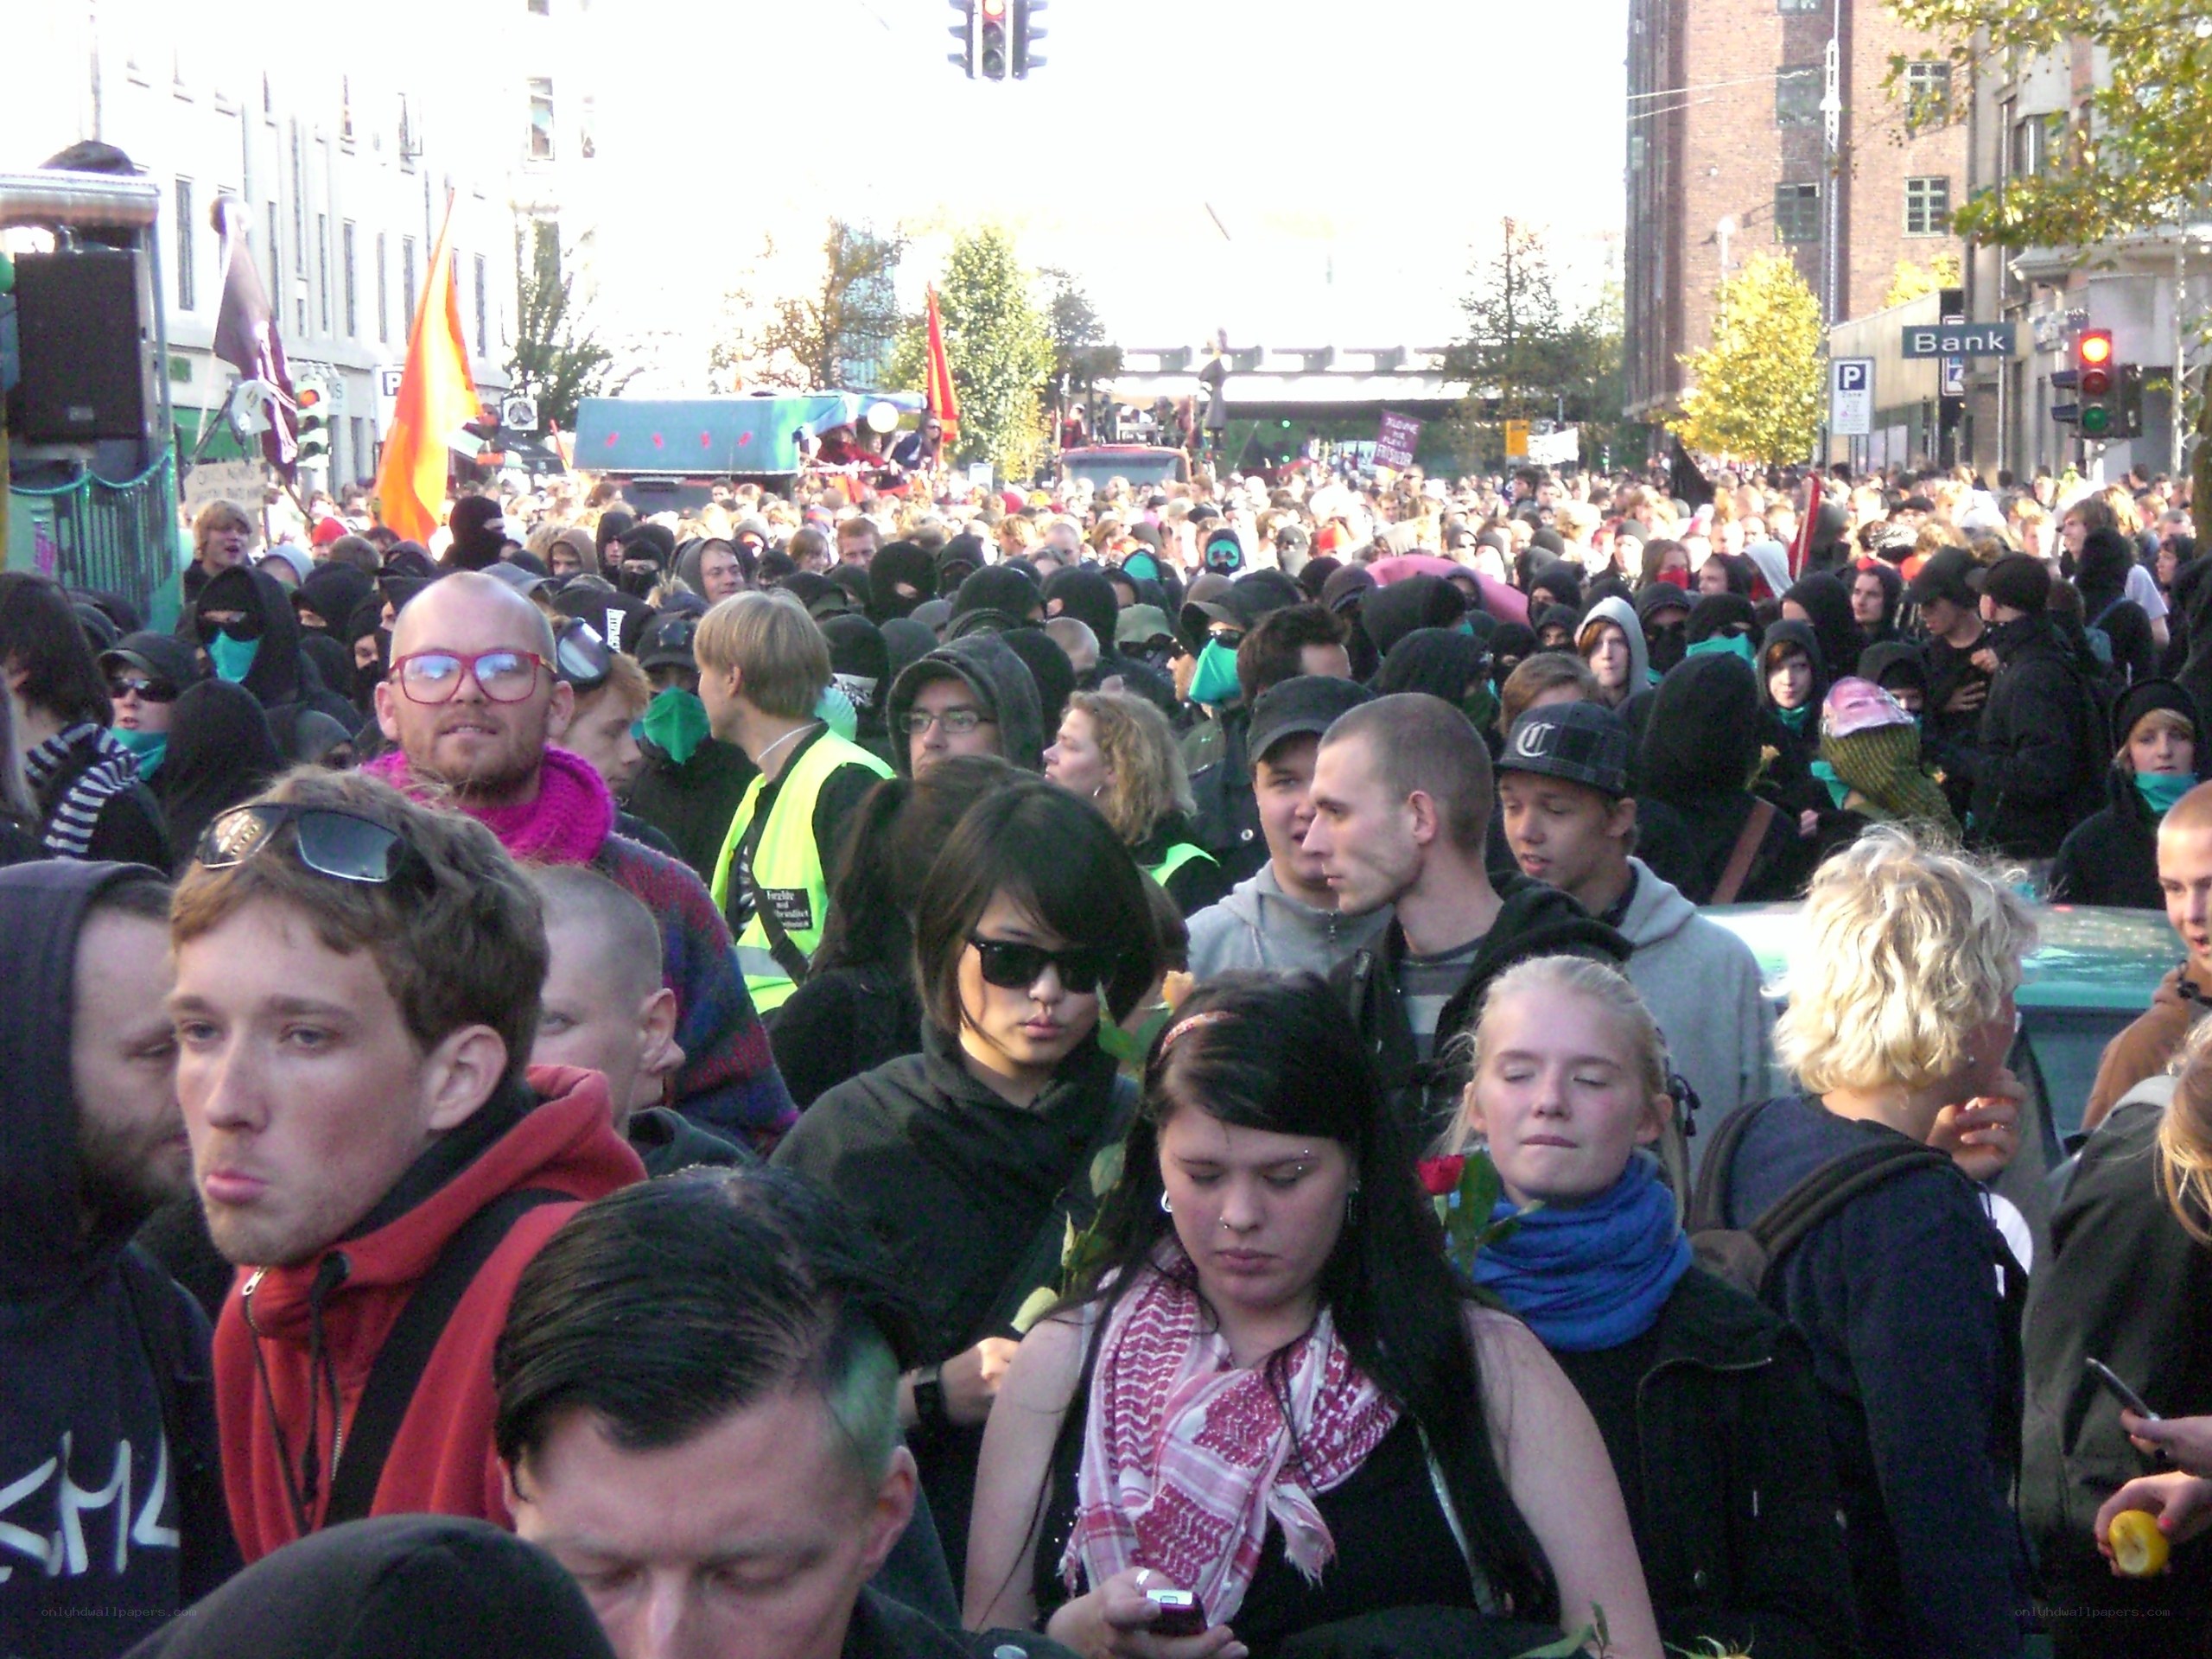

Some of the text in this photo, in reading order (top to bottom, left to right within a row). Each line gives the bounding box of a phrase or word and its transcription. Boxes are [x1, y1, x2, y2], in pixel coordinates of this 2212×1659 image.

[1915, 331, 2005, 353] Bank
[386, 372, 403, 396] P
[1844, 365, 1861, 389] P
[1516, 721, 1555, 757] C
